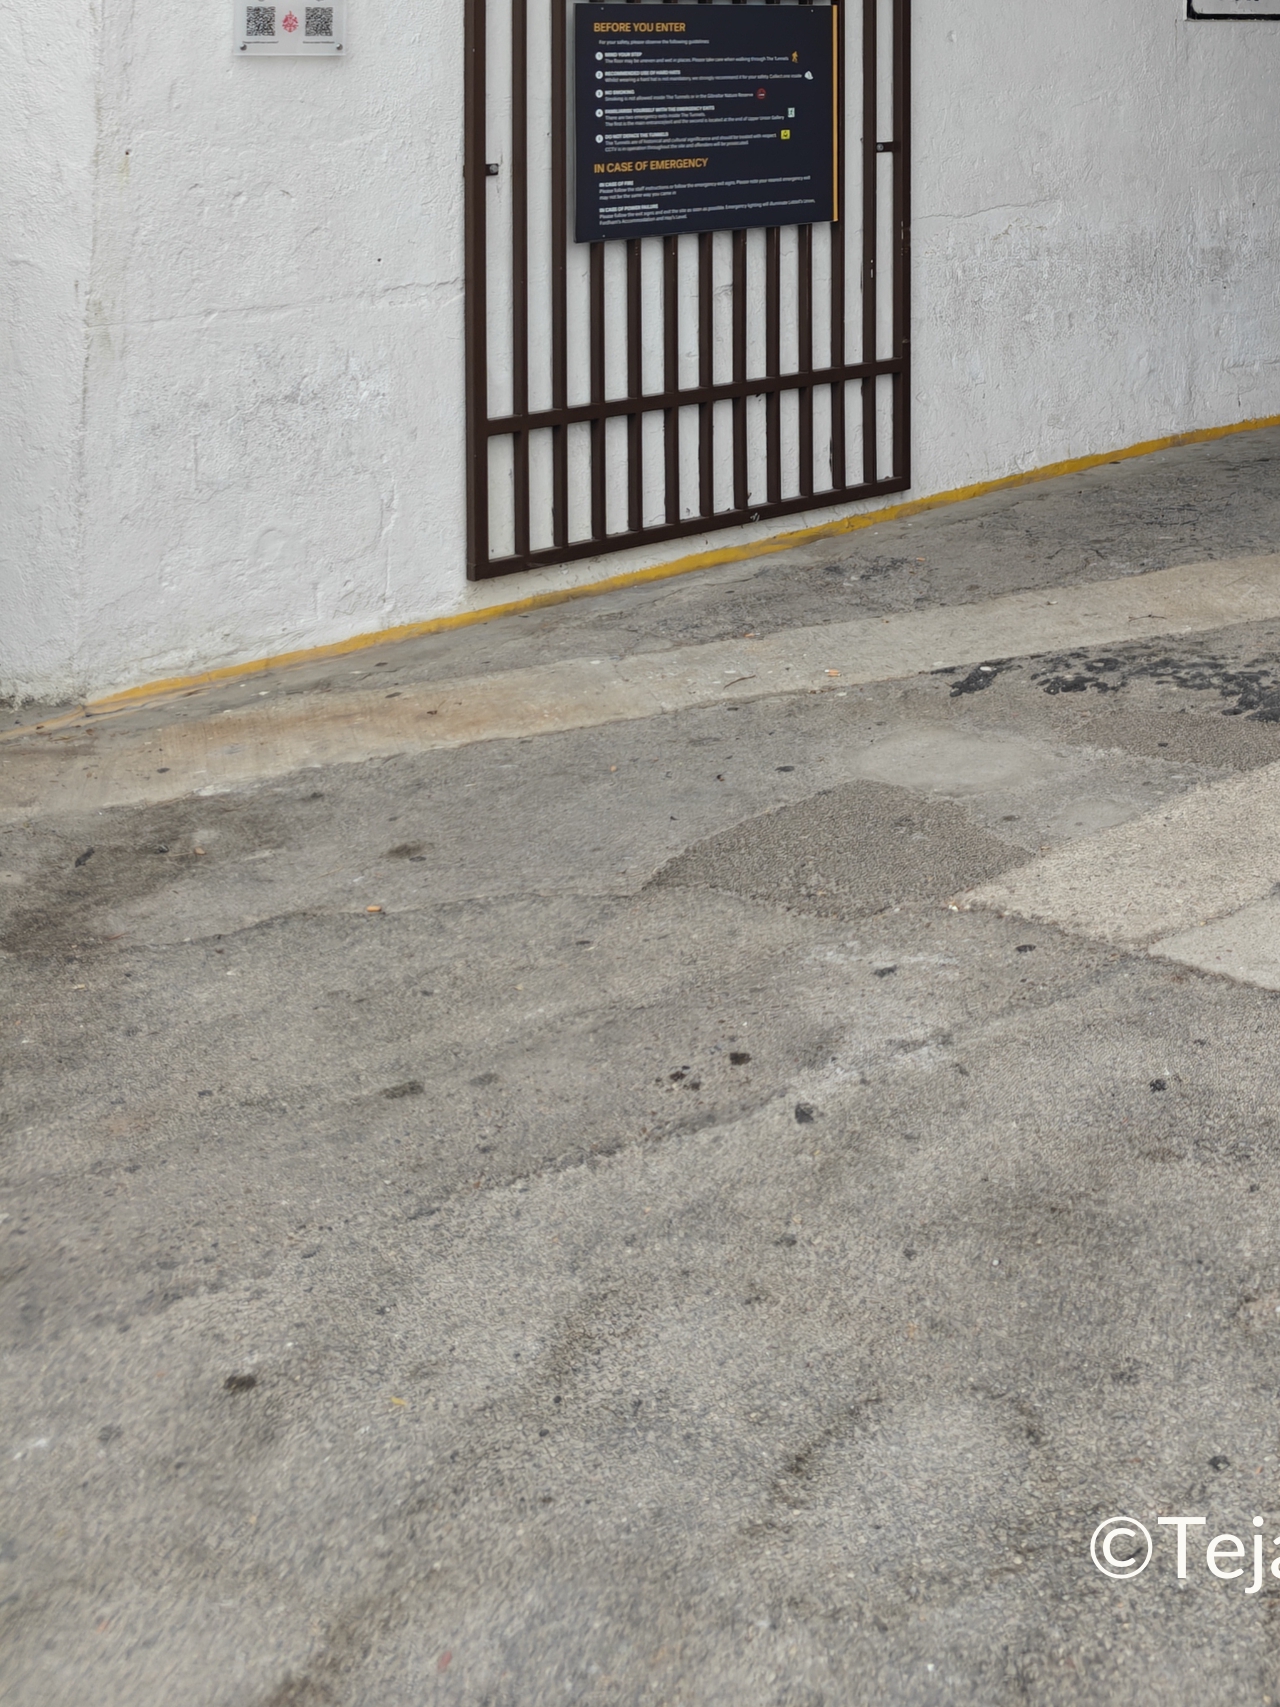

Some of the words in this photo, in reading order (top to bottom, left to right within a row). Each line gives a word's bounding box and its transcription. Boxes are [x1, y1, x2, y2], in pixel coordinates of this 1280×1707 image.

[594, 22, 631, 33] BEFORE
[633, 22, 654, 33] YOU
[656, 22, 686, 32] ENTER
[594, 163, 605, 174] IN
[607, 161, 633, 173] CASE
[635, 160, 648, 171] OF
[650, 158, 708, 170] EMERGENCY
